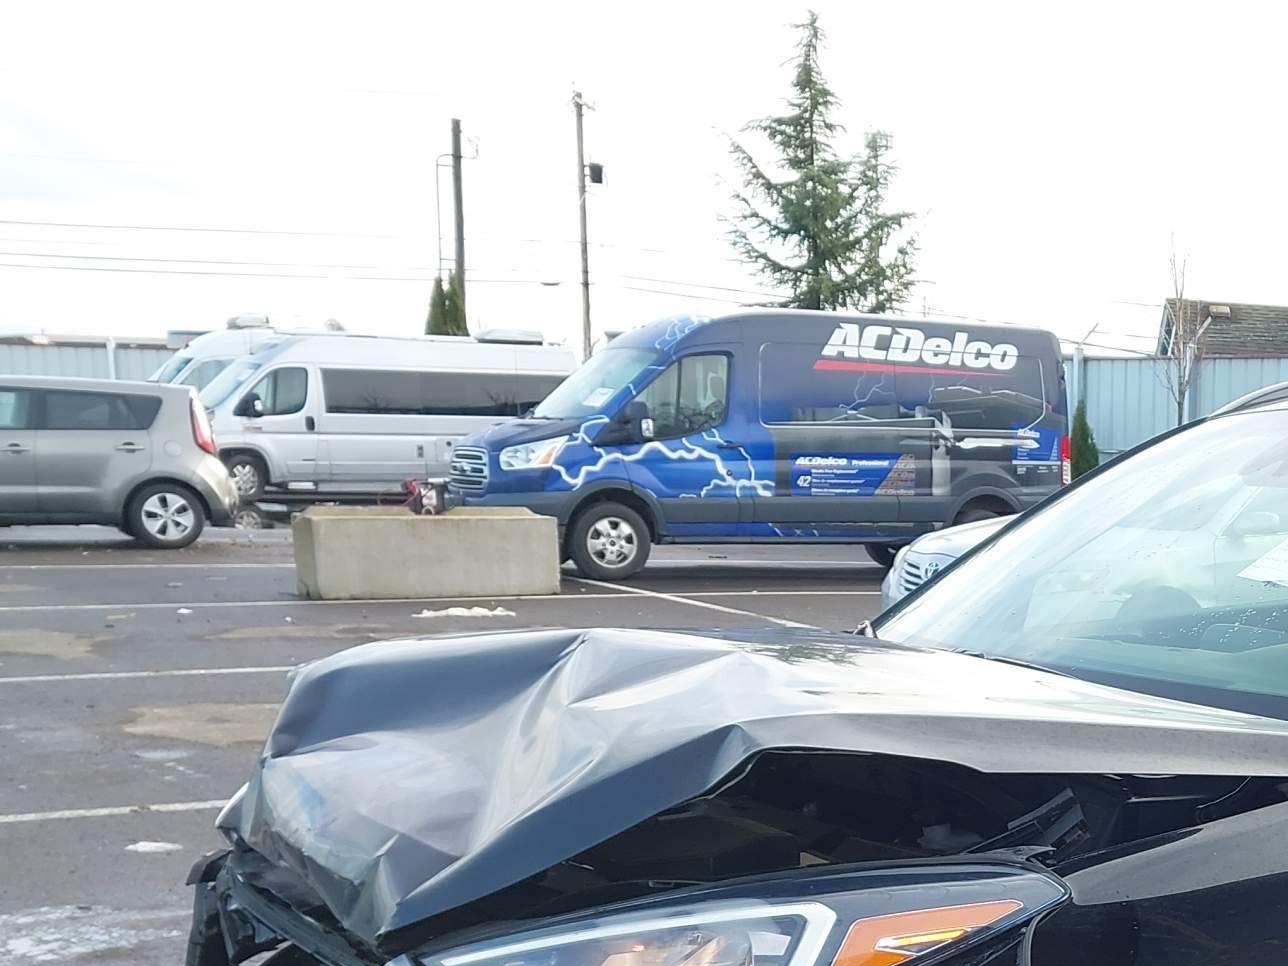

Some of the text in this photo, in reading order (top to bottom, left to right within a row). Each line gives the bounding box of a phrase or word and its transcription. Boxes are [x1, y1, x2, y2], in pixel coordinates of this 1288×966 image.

[821, 322, 1019, 370] ACDelco
[795, 456, 848, 465] ACDelco
[797, 475, 812, 487] 42
